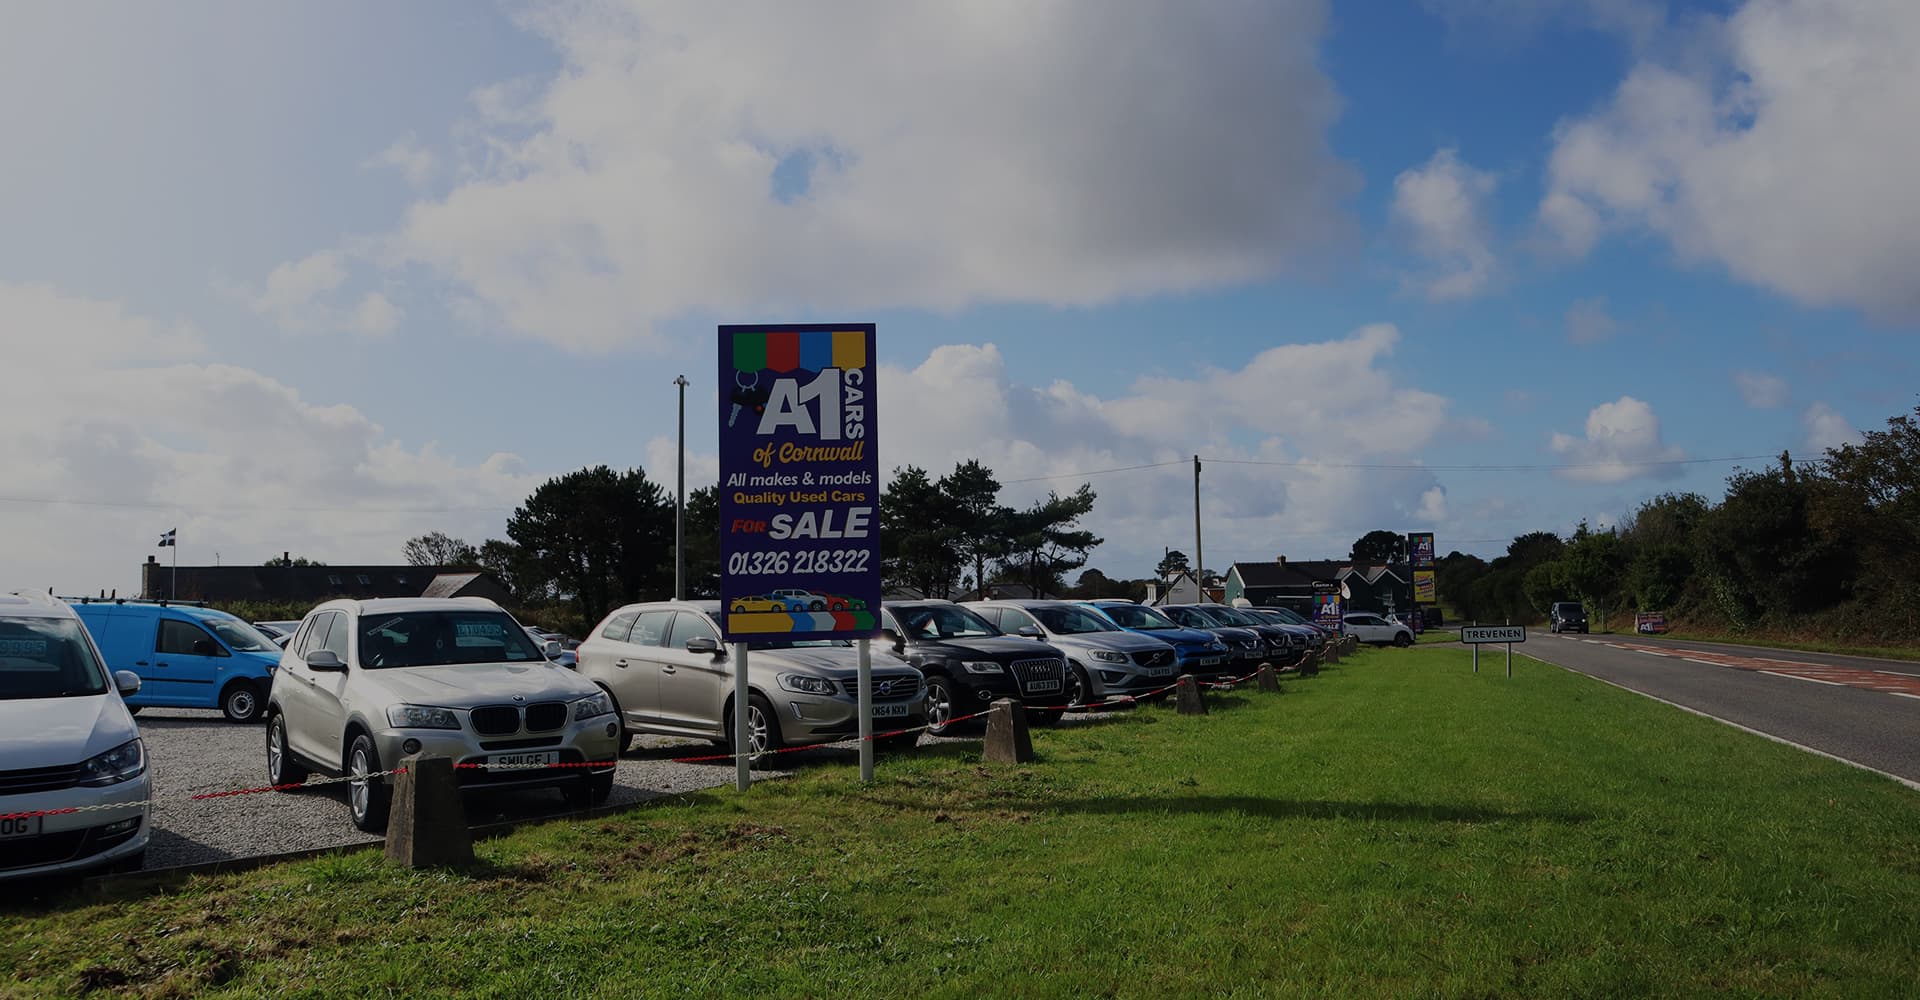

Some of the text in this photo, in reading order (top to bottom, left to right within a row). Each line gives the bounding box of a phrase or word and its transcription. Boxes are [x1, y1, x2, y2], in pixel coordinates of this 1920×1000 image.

[756, 368, 840, 440] A1
[844, 368, 865, 440] CARS
[752, 440, 865, 468] of Cornwall
[726, 470, 872, 487] All makes & models
[733, 490, 866, 506] Quality Used Cars
[731, 507, 873, 540] FOR SALE
[728, 549, 870, 575] 01326 218322
[1466, 630, 1521, 638] TREVENEN
